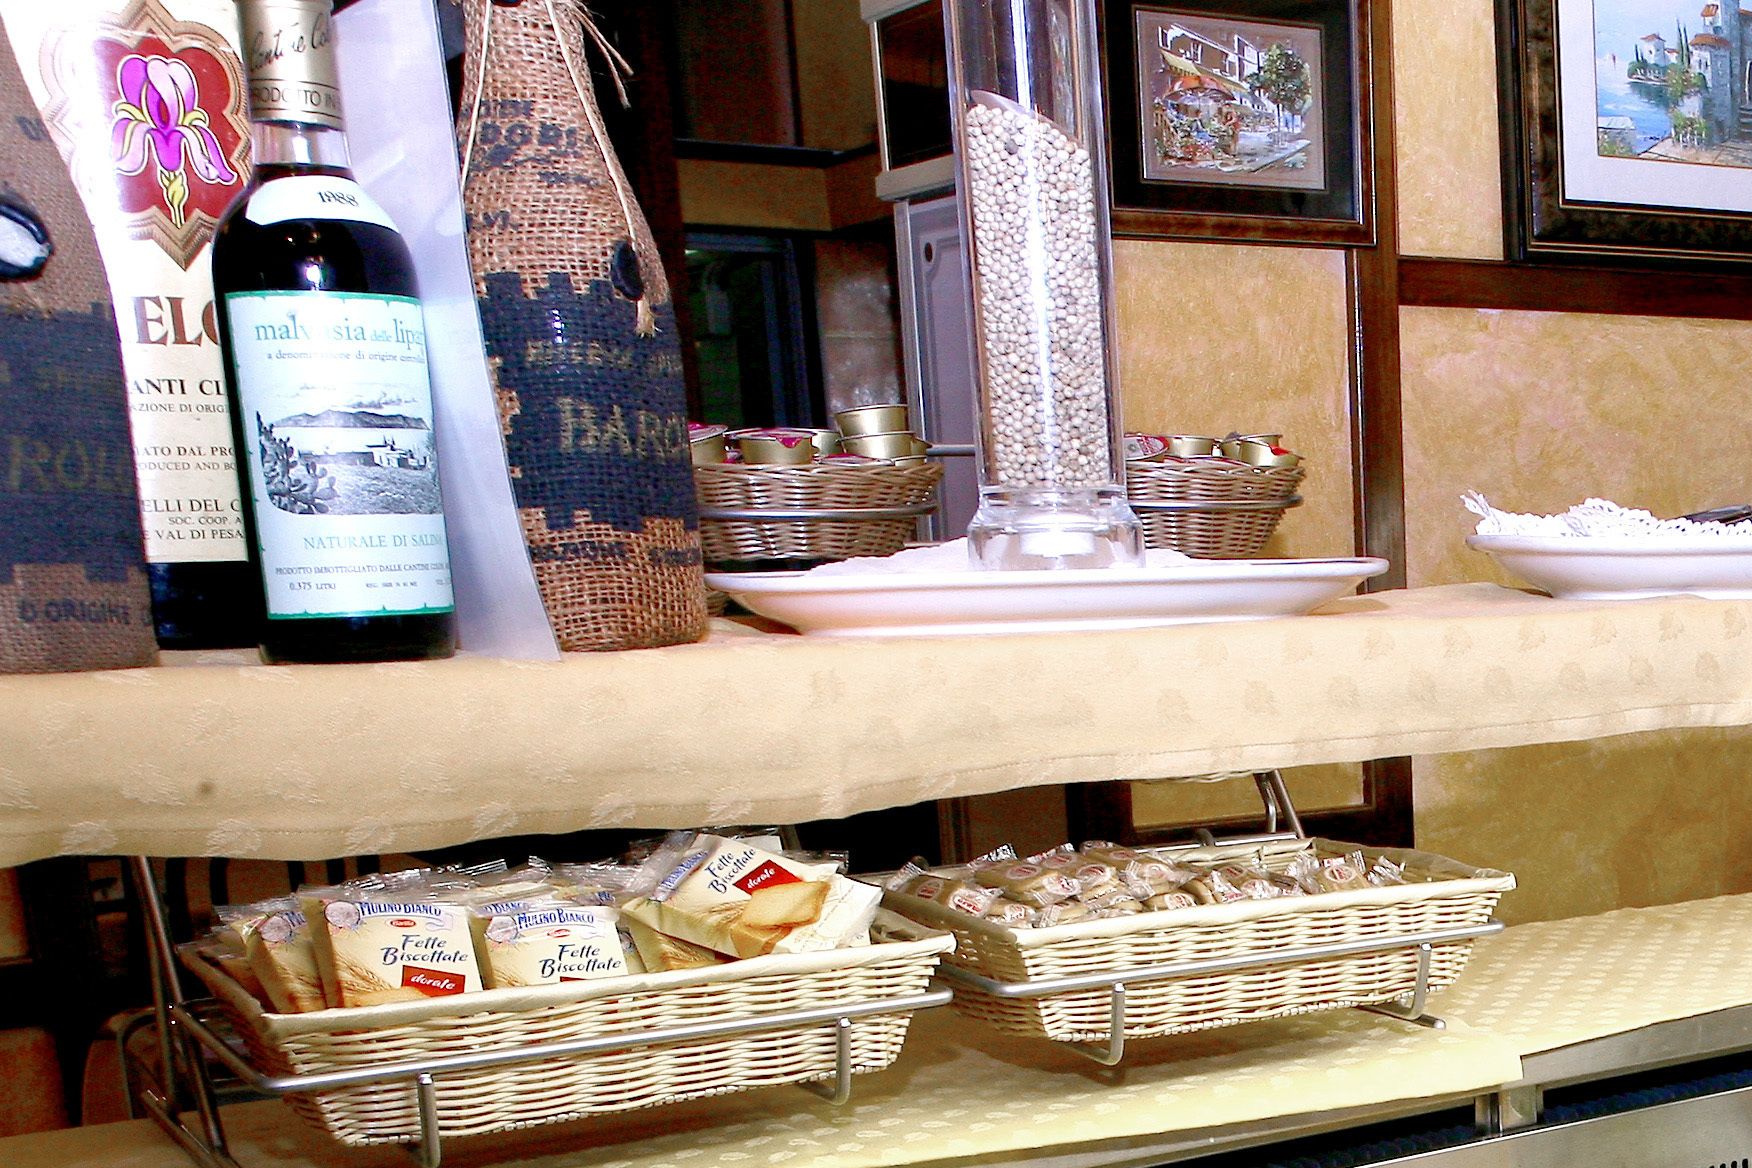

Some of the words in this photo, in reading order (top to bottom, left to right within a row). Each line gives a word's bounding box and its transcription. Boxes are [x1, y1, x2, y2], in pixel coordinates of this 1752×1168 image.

[255, 312, 367, 341] malvsia
[180, 403, 192, 412] DI
[176, 447, 206, 457] DAL
[195, 462, 220, 470] AND
[189, 499, 224, 513] DEL
[168, 516, 194, 525] SOC.
[198, 516, 231, 525] COOP.
[155, 530, 186, 540] VAL
[190, 529, 206, 540] DI
[304, 535, 388, 550] NATURALE
[392, 534, 407, 548] DI
[275, 567, 313, 576] PRODOTTO
[314, 564, 378, 575] IMBOTTIGLIATO
[379, 564, 402, 573] DALLE
[704, 851, 734, 878] Fette
[708, 848, 757, 894] Biscottate
[746, 867, 777, 889] dorate
[358, 902, 401, 917] MULINO
[518, 911, 556, 930] MULINO
[558, 908, 595, 925] BIANCO
[401, 934, 448, 950] Fette
[380, 947, 469, 966] Biscottate
[558, 943, 601, 962] Fette
[539, 958, 622, 979] Biscottate
[410, 973, 456, 990] dorate
